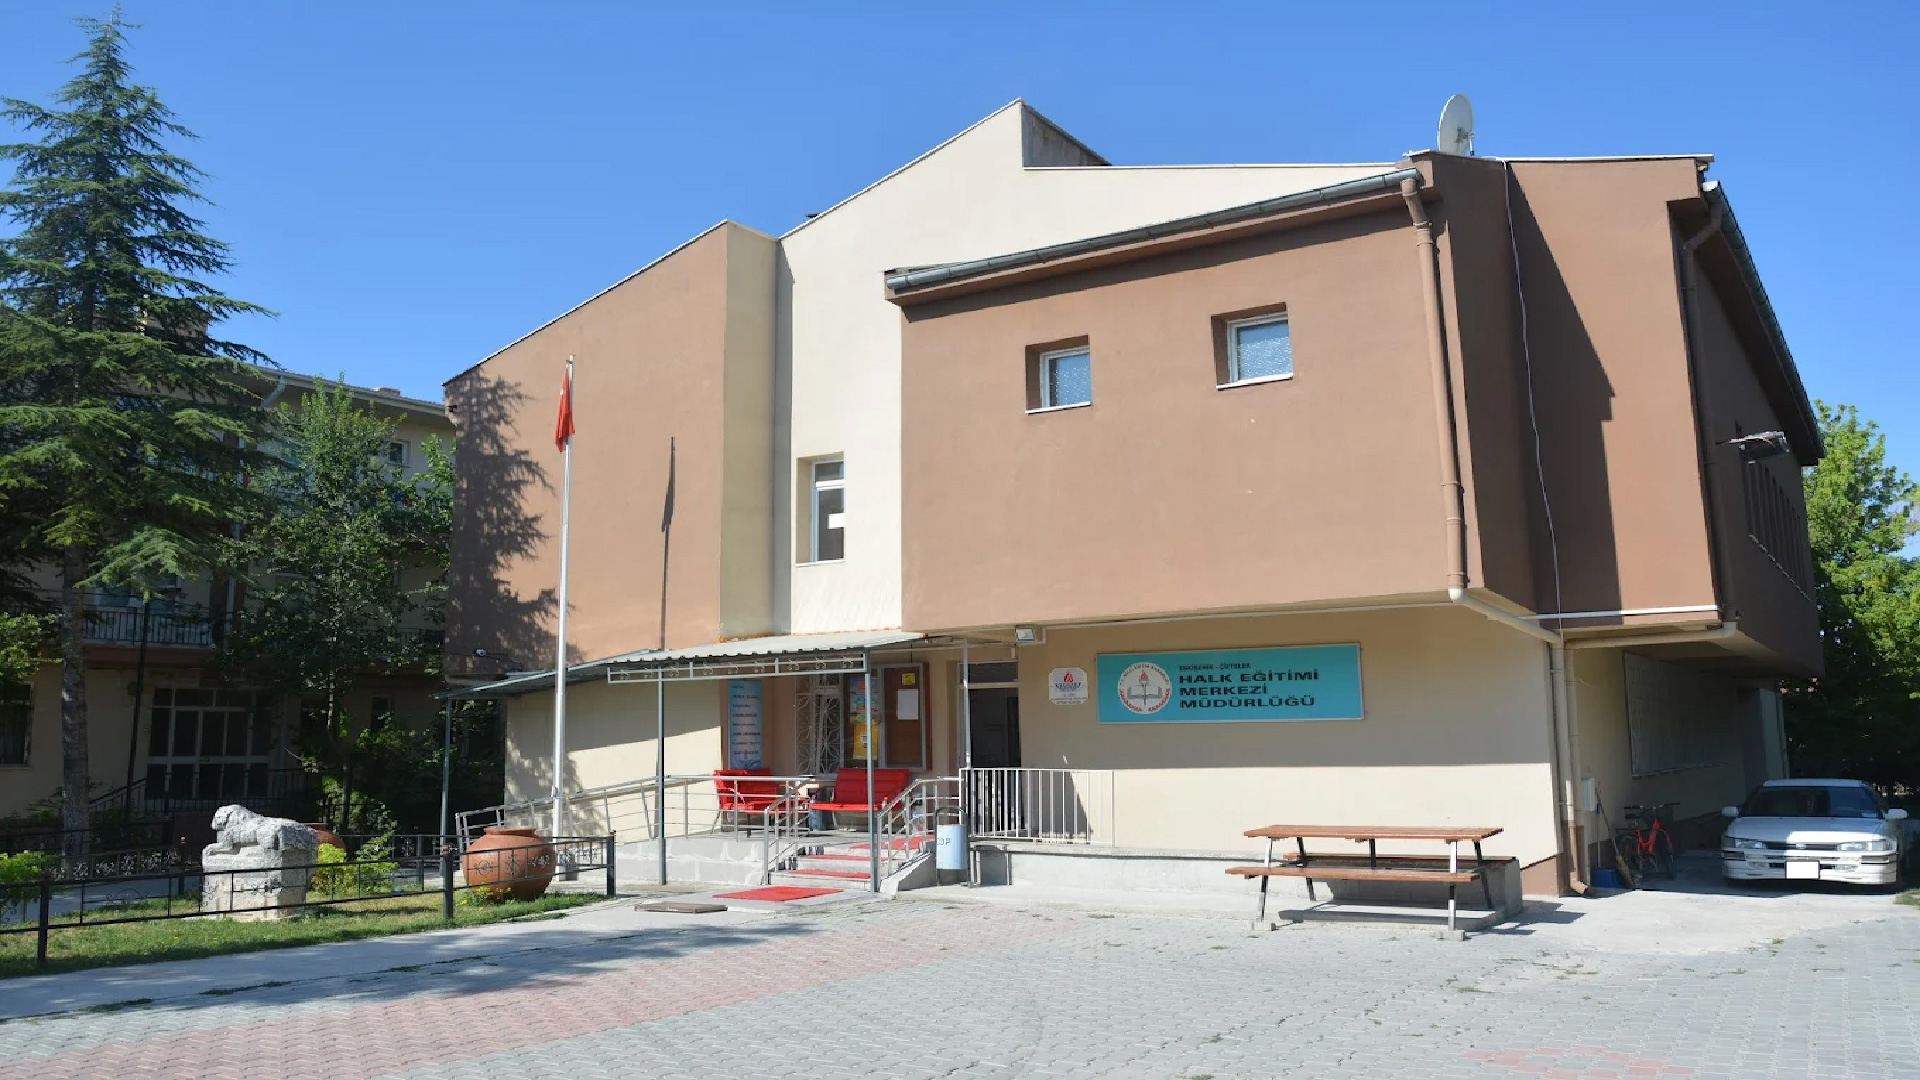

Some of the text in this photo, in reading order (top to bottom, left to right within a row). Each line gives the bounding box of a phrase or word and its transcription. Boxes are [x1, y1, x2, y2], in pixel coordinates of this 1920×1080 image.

[1179, 674, 1232, 683] HALK
[1240, 668, 1320, 682] EĞİTİMİ
[1180, 683, 1268, 696] MERKEZİ
[1180, 694, 1316, 708] MÜDÜRLÜĞÜ
